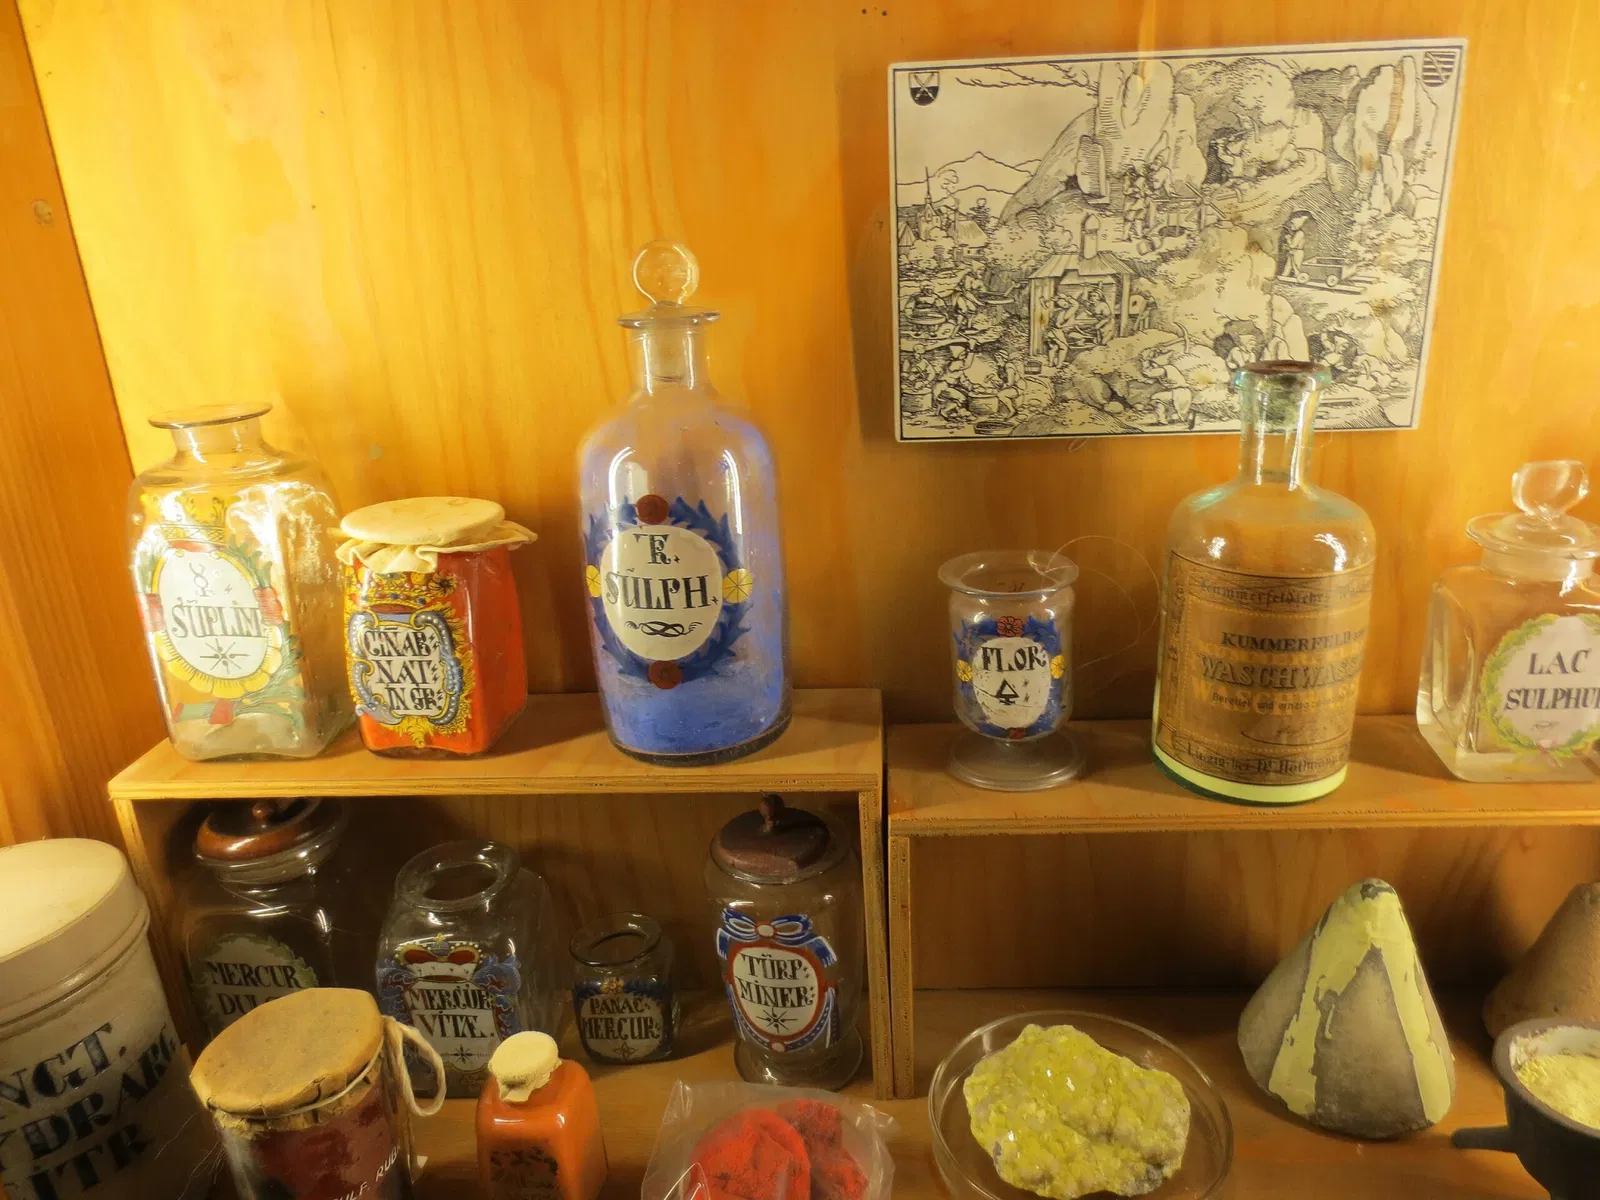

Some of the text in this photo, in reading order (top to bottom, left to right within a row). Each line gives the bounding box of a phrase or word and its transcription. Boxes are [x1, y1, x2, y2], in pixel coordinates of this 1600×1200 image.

[1527, 649, 1592, 676] LAC
[1256, 700, 1274, 711] und
[217, 992, 283, 1016] DUL
